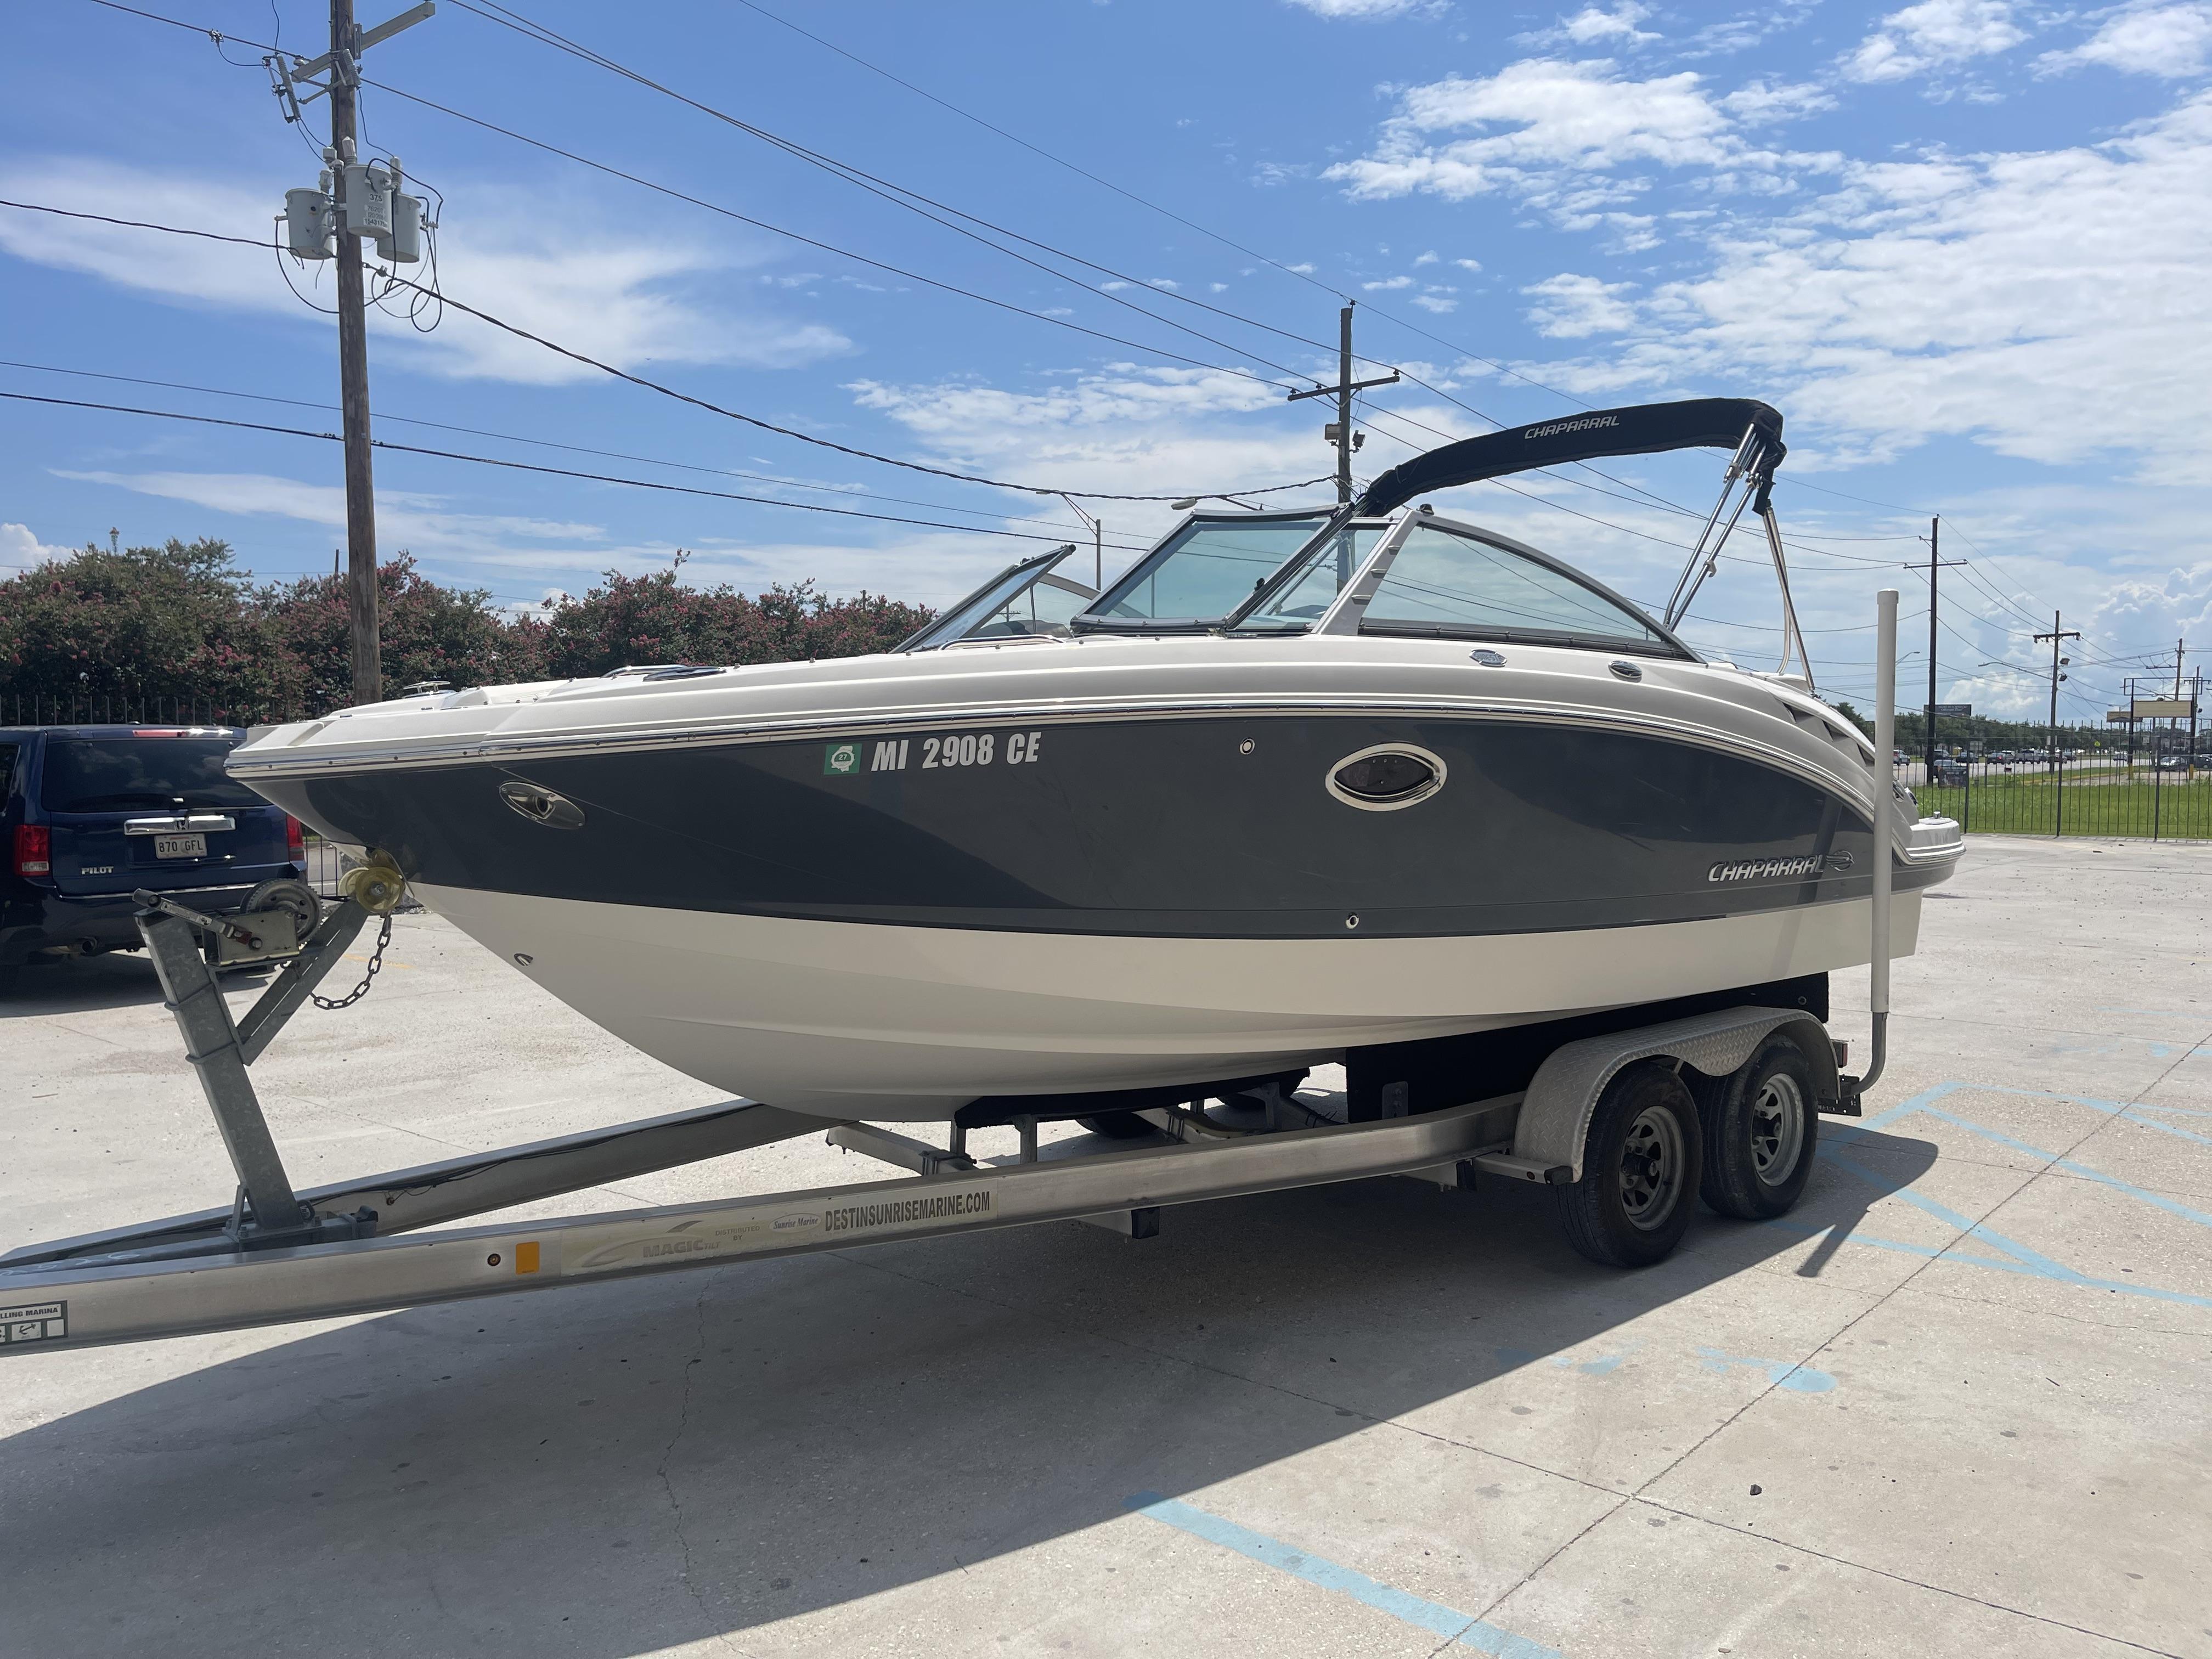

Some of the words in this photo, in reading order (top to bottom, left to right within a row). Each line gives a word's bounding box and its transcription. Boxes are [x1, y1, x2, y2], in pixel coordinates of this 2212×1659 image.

[1525, 415, 1620, 439] CHAPARRAL
[871, 740, 909, 771] MI
[922, 734, 995, 769] 2908
[1006, 732, 1041, 765] CE
[159, 841, 178, 853] 870
[185, 840, 204, 851] GFL
[81, 866, 114, 875] PILOT
[1708, 854, 1825, 882] CHAPARRAL
[825, 1191, 990, 1231] DESTINSUNRISEMARINE.COM
[773, 1219, 796, 1229] Sunrise
[797, 1216, 819, 1226] Marine
[715, 1225, 760, 1236] DISTRIBUTED
[26, 1307, 58, 1316] MARINA
